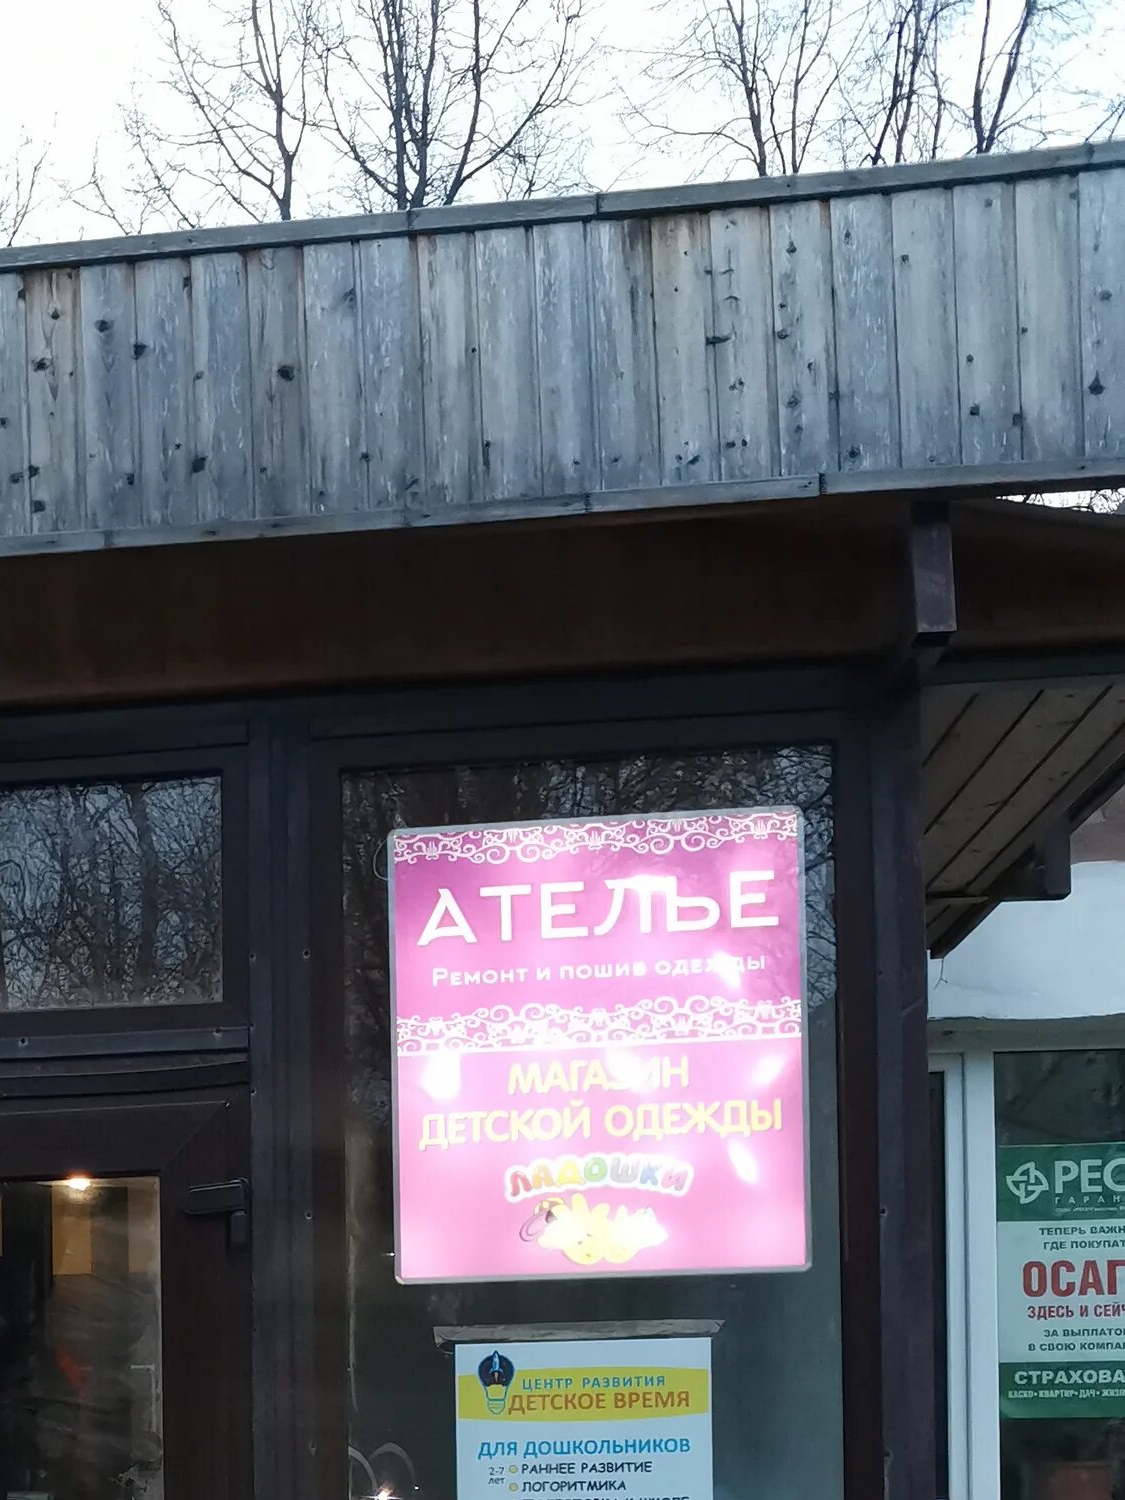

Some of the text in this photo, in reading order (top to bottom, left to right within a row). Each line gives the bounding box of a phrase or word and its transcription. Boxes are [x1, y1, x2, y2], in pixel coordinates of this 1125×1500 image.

[416, 869, 780, 946] АТЕЛЬЕ
[418, 1098, 784, 1151] ДЕТСКОЙ ОДЕЖДЫ
[508, 1155, 690, 1198] ЛАДОШКИ
[1039, 1226, 1086, 1236] ТЕПЕРЬ
[1043, 1241, 1067, 1251] ГДЕ
[1027, 1304, 1074, 1320] ЗДЕСЬ
[1079, 1304, 1089, 1318] И
[1043, 1328, 1125, 1338] ЗА ВЫПЛАТО
[1027, 1341, 1125, 1351] В СВОЮ КОМПА
[522, 1375, 666, 1391] ЦЕНТР РАЗВИТИЯ
[507, 1390, 691, 1415] ДЕТСКОЕ ВРЕМЯ
[477, 1437, 691, 1460] ДЛЯ ДОШКОЛЬНИКОВ
[488, 1466, 505, 1476] 2-7
[521, 1461, 653, 1475] РАННЕЕ РАЗВИТИЕ
[487, 1476, 505, 1485] лет
[522, 1480, 627, 1493] ЛОГОРИТМИКА
